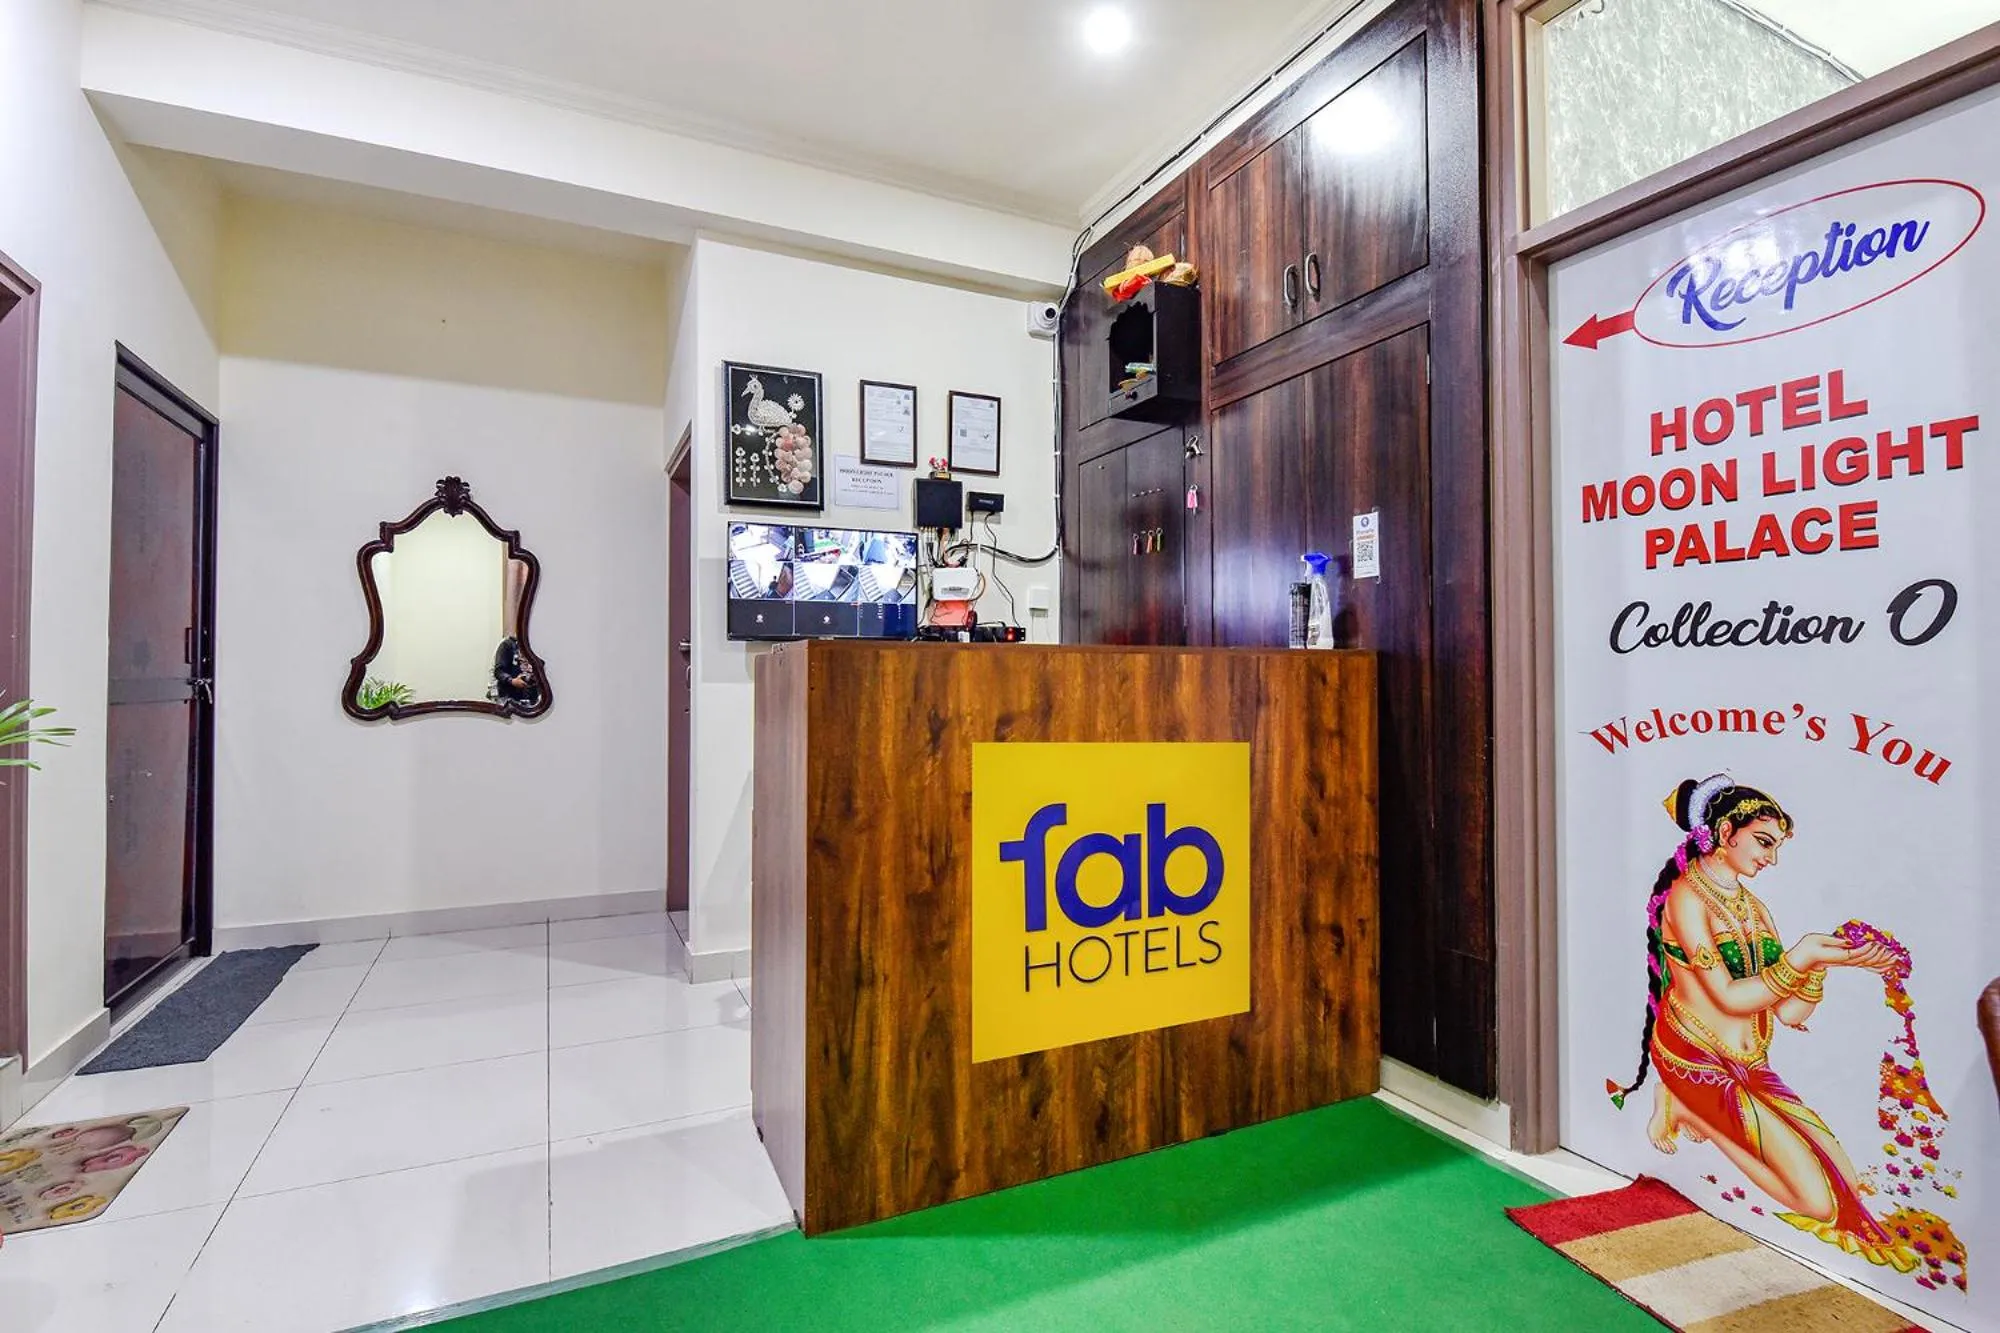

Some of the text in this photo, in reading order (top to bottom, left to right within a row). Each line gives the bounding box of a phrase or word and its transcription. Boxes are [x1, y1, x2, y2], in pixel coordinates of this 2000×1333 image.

[1665, 219, 1932, 332] Reception
[1649, 368, 1869, 457] HOTEL
[1582, 415, 1980, 524] MOON LIGHT
[1645, 500, 1880, 570] PALACE
[1609, 578, 1959, 655] Collection O
[1579, 703, 1953, 787] Welcome's You
[1000, 803, 1225, 932] fab
[1024, 920, 1223, 993] HOTELS
